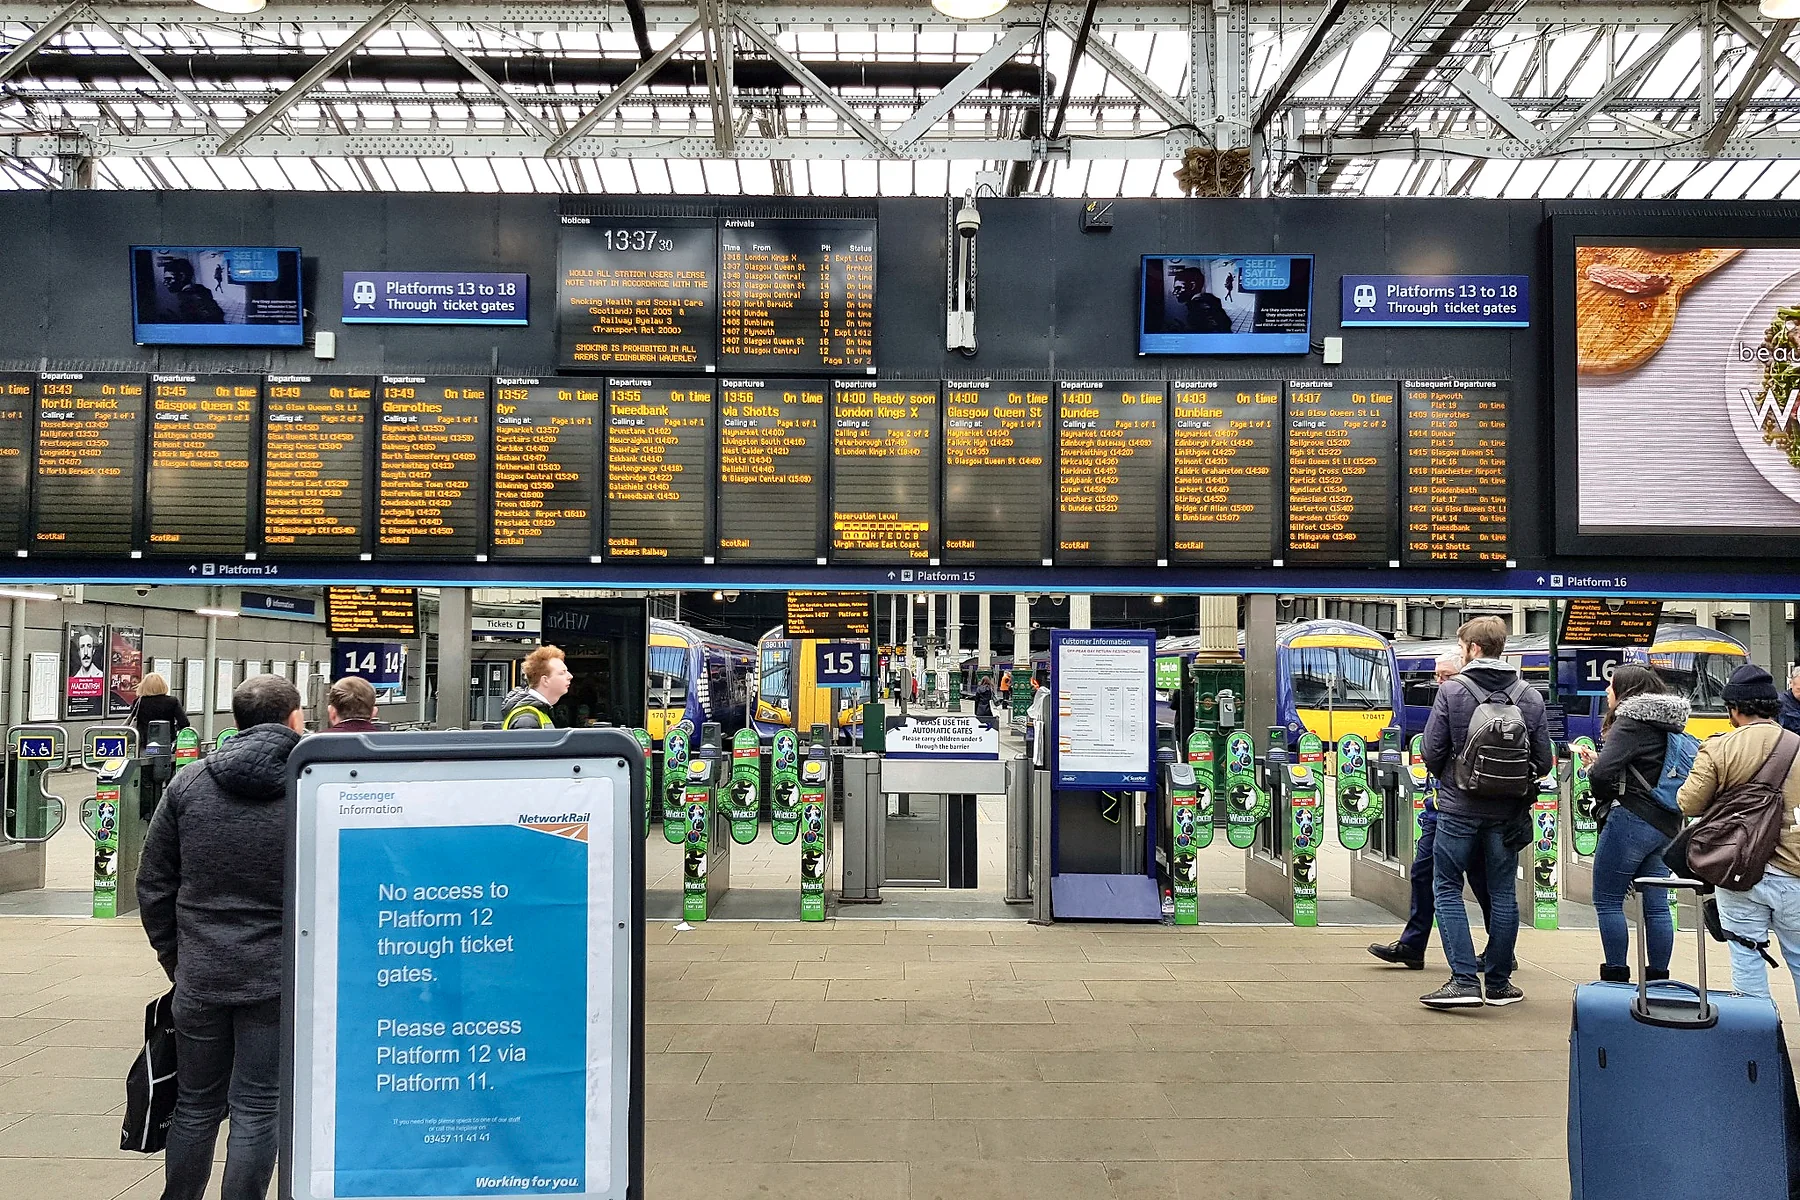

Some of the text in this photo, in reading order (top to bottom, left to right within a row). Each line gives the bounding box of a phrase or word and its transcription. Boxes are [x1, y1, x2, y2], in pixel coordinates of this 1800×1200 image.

[605, 230, 657, 250] 13:37
[659, 240, 673, 250] 30
[1245, 269, 1275, 277] SAY IT.
[1245, 278, 1288, 286] SORTED.
[387, 282, 515, 295] Platforms 13 to 18
[1388, 285, 1517, 297] Platforms 13 to 18
[387, 299, 514, 313] Through ticket gates
[1388, 302, 1516, 315] Through ticket gates
[42, 373, 83, 381] Departures
[153, 375, 195, 383] Departures
[383, 376, 425, 384] Departures
[610, 379, 651, 387] Departures
[723, 380, 764, 388] Departures
[835, 381, 876, 389] Departures
[1175, 381, 1217, 389] Departures
[1290, 381, 1332, 389] Departures
[1405, 381, 1496, 389] Subsequent Departures
[102, 385, 115, 395] On
[120, 385, 142, 395] time
[156, 386, 256, 397] 13:45 On time
[330, 388, 343, 397] On
[348, 388, 370, 398] time
[444, 389, 458, 398] On
[463, 389, 485, 399] time
[498, 390, 598, 401] 13:52 On time
[612, 391, 710, 402] 13:55 On time
[724, 393, 823, 403] 13:56 On time
[836, 393, 935, 405] 14:00 Ready soon
[949, 393, 1048, 404] 14:00 On time
[1062, 394, 1162, 404] 14:00 On time
[1177, 393, 1277, 404] 14:03 On time
[1291, 393, 1392, 404] 14:07 On time
[41, 399, 118, 409] North Berwick
[155, 401, 250, 411] Glasgow Queen St
[383, 403, 441, 413] Glenrothes
[497, 404, 517, 414] Ayr
[611, 405, 668, 415] Tweedbank
[723, 407, 779, 417] via Shotts
[835, 407, 918, 418] London Kings X
[948, 408, 1042, 419] Glasgow Queen St
[1061, 408, 1098, 418] Dundee
[1175, 408, 1222, 418] Dunblane
[219, 565, 278, 575] Platform 14
[918, 572, 975, 581] Platform 15
[1568, 577, 1626, 587] Platform 16
[487, 620, 513, 628] Tickets
[345, 652, 399, 673] 14 14
[824, 653, 853, 674] 15
[1586, 660, 1616, 681] 16
[912, 727, 947, 735] AUTOMATIC
[339, 791, 395, 802] Passenger
[339, 804, 403, 814] Information
[378, 882, 508, 901] No access to
[378, 909, 493, 928] Platform 12
[378, 935, 513, 958] through ticket
[377, 966, 437, 987] gates.
[377, 1019, 522, 1037] Please access
[377, 1044, 526, 1064] Platform 12 via
[377, 1073, 494, 1092] Platform 11.
[424, 1135, 450, 1143] 03457
[454, 1135, 463, 1143] 11
[466, 1134, 477, 1142] 41
[476, 1177, 579, 1190] Working for you.
